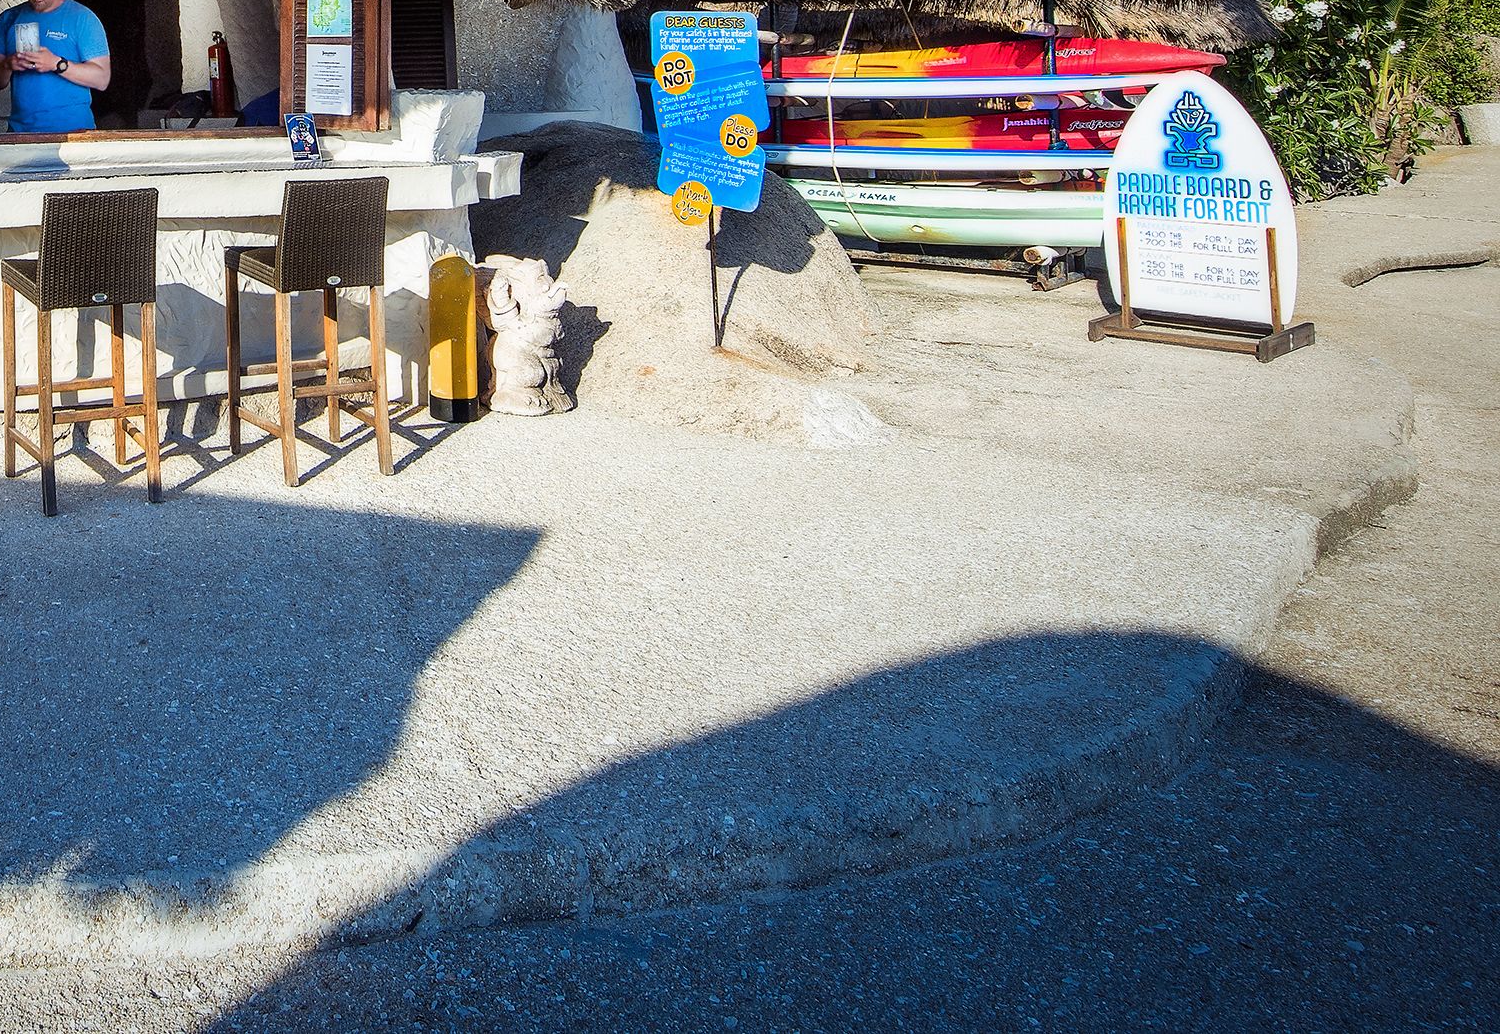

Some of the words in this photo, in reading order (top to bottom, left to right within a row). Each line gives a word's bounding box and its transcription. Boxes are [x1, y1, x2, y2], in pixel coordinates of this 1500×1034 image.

[666, 16, 696, 28] DEAR
[698, 17, 745, 29] GUESTS
[663, 59, 686, 72] DO
[662, 70, 692, 88] NOT
[683, 115, 695, 123] the
[725, 117, 755, 137] Please
[1003, 117, 1049, 132] Jamahki
[725, 133, 748, 149] DO
[670, 158, 691, 168] Check
[670, 164, 685, 174] Take
[1117, 172, 1181, 195] PADDLE
[1186, 175, 1251, 199] BOARD
[1259, 179, 1273, 201] &
[859, 192, 897, 202] KAYAK
[1118, 193, 1177, 217] KAYAK
[1183, 197, 1218, 220] FOR
[1223, 200, 1271, 224] RENT
[1145, 230, 1166, 238] 400
[1205, 235, 1221, 243] FOR
[1238, 238, 1257, 246] DAY
[1145, 238, 1166, 247] 700
[1193, 242, 1209, 250] FOR
[1212, 244, 1232, 253] FULL
[1238, 246, 1258, 254] DAY
[1146, 260, 1166, 269] 250
[1206, 266, 1223, 274] FOR
[1239, 269, 1259, 278] DAY
[1146, 268, 1166, 277] 400
[1194, 273, 1213, 282] FOR
[1216, 276, 1236, 285] FULL
[1240, 277, 1260, 286] DAY
